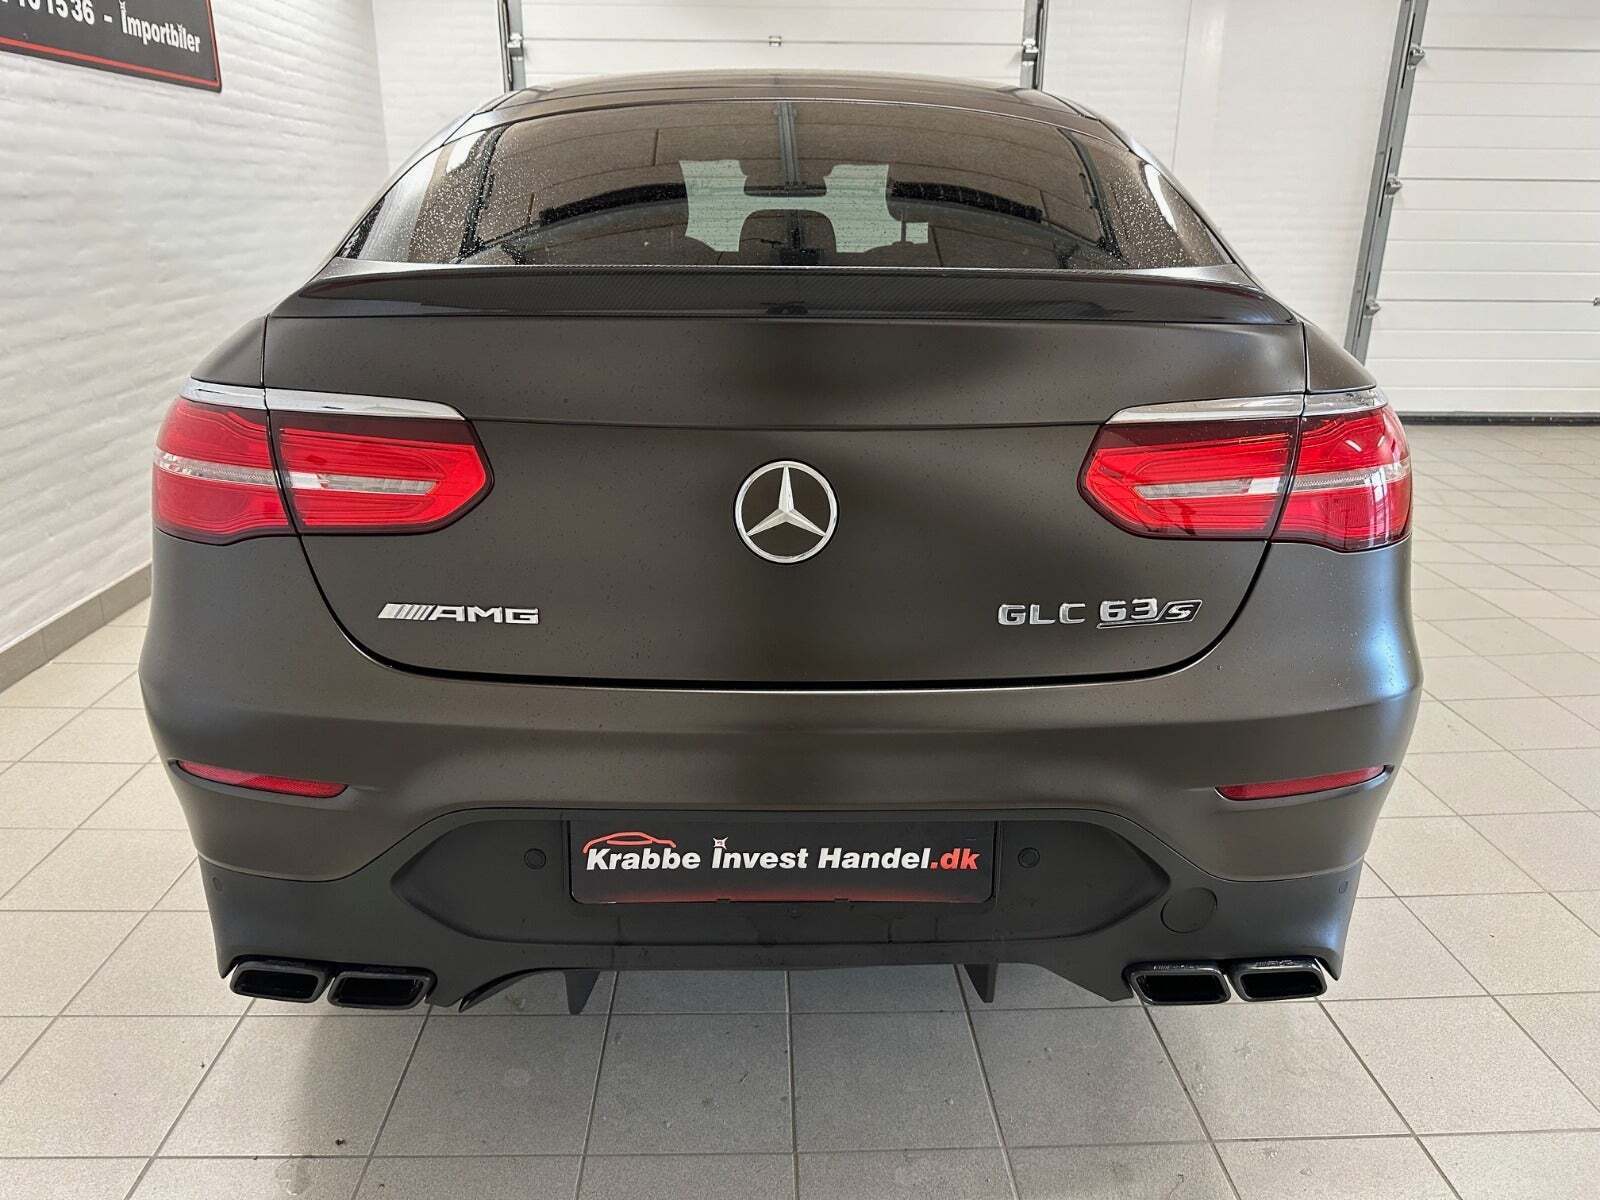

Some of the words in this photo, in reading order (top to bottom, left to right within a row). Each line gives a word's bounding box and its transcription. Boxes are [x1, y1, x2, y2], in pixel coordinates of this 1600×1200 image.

[119, 1, 201, 53] Importbiler
[428, 605, 539, 625] AMG
[998, 603, 1087, 626] GLC
[586, 847, 701, 871] Krabbe
[711, 838, 809, 869] Invest
[818, 846, 980, 870] Handel.dk
